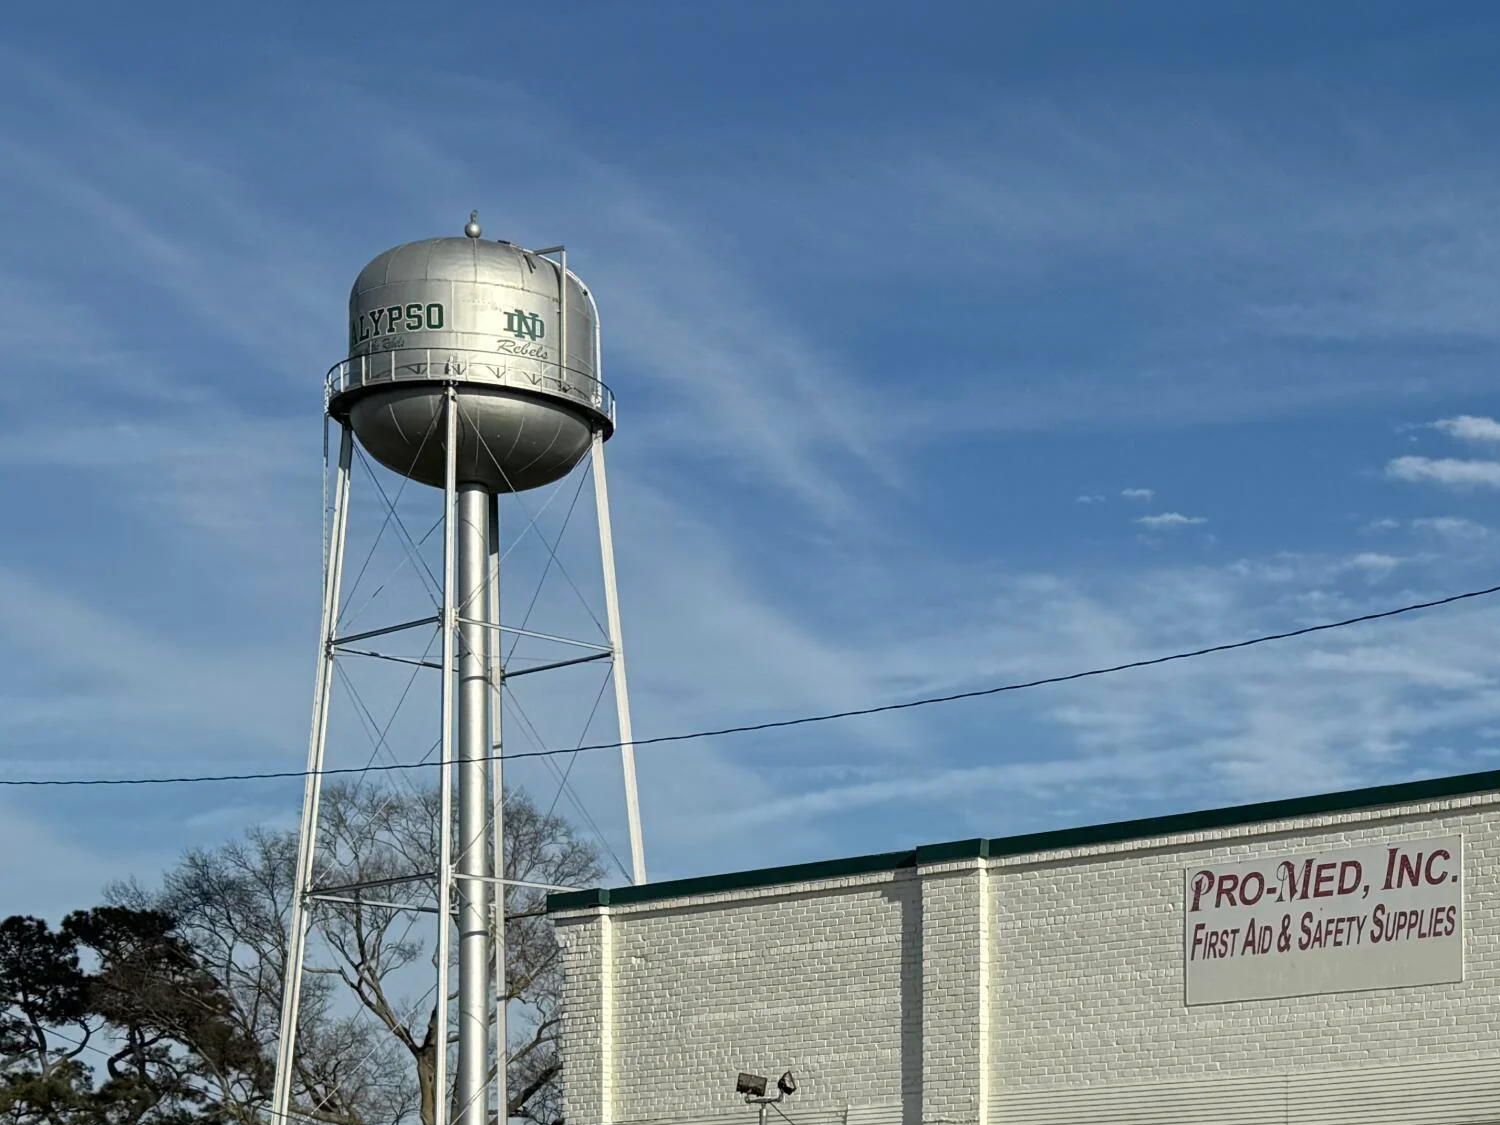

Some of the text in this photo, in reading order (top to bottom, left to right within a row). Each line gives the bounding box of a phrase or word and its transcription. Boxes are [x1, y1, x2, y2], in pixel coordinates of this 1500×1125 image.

[496, 339, 548, 360] Rebels
[1380, 848, 1458, 890] INC.
[1190, 903, 1456, 961] FIRST AID & SAFETY SUPPLIES
